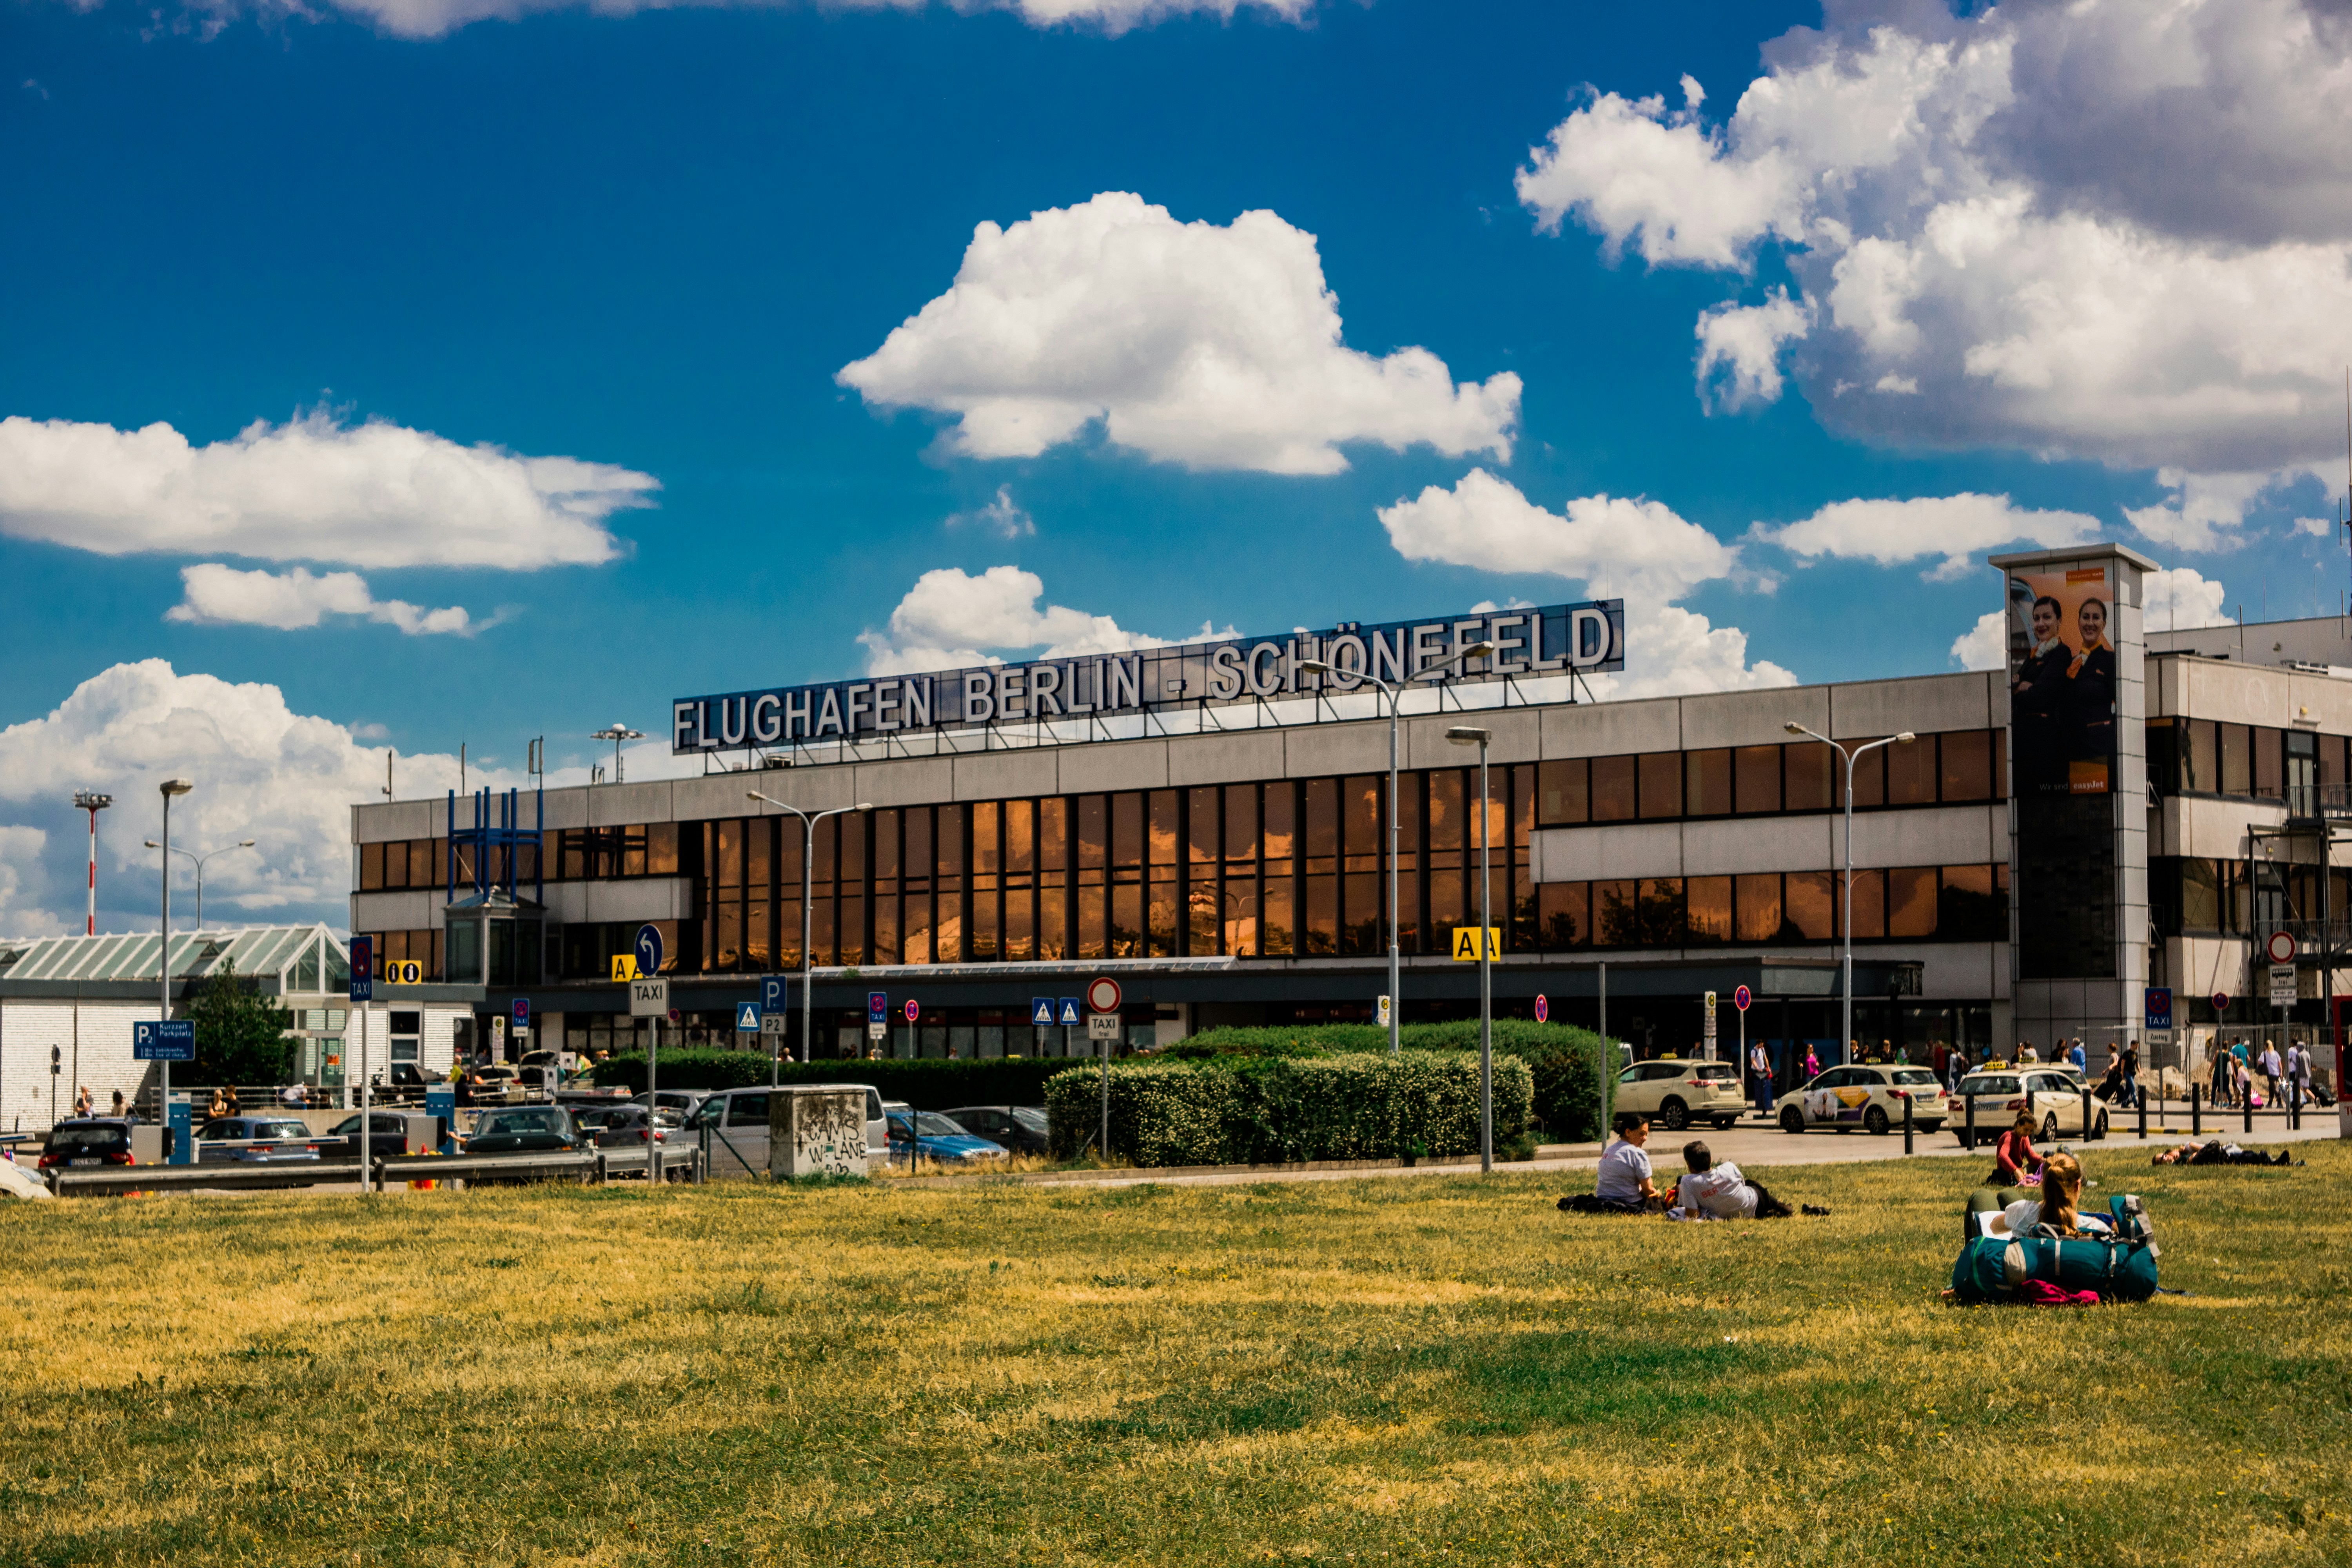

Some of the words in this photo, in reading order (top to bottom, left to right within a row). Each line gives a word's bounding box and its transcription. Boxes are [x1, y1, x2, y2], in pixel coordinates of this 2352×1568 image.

[673, 676, 935, 750] FLUGHAFEN
[964, 655, 1143, 724] BERLIN
[1210, 608, 1612, 701] SCHÖNEFELD
[2054, 782, 2068, 790] sind
[2073, 780, 2104, 790] easyJet
[1457, 931, 1475, 957] A
[615, 958, 626, 978] A
[352, 982, 370, 996] TAXI
[634, 984, 662, 1000] TAXI
[767, 981, 780, 1008] P
[1092, 1018, 1115, 1029] TAXI
[2148, 1017, 2169, 1025] TAXI
[2151, 1033, 2168, 1042] Zustieg
[809, 1118, 859, 1142] CAMS
[833, 1139, 867, 1160] LANE
[1701, 1186, 1718, 1199] BER
